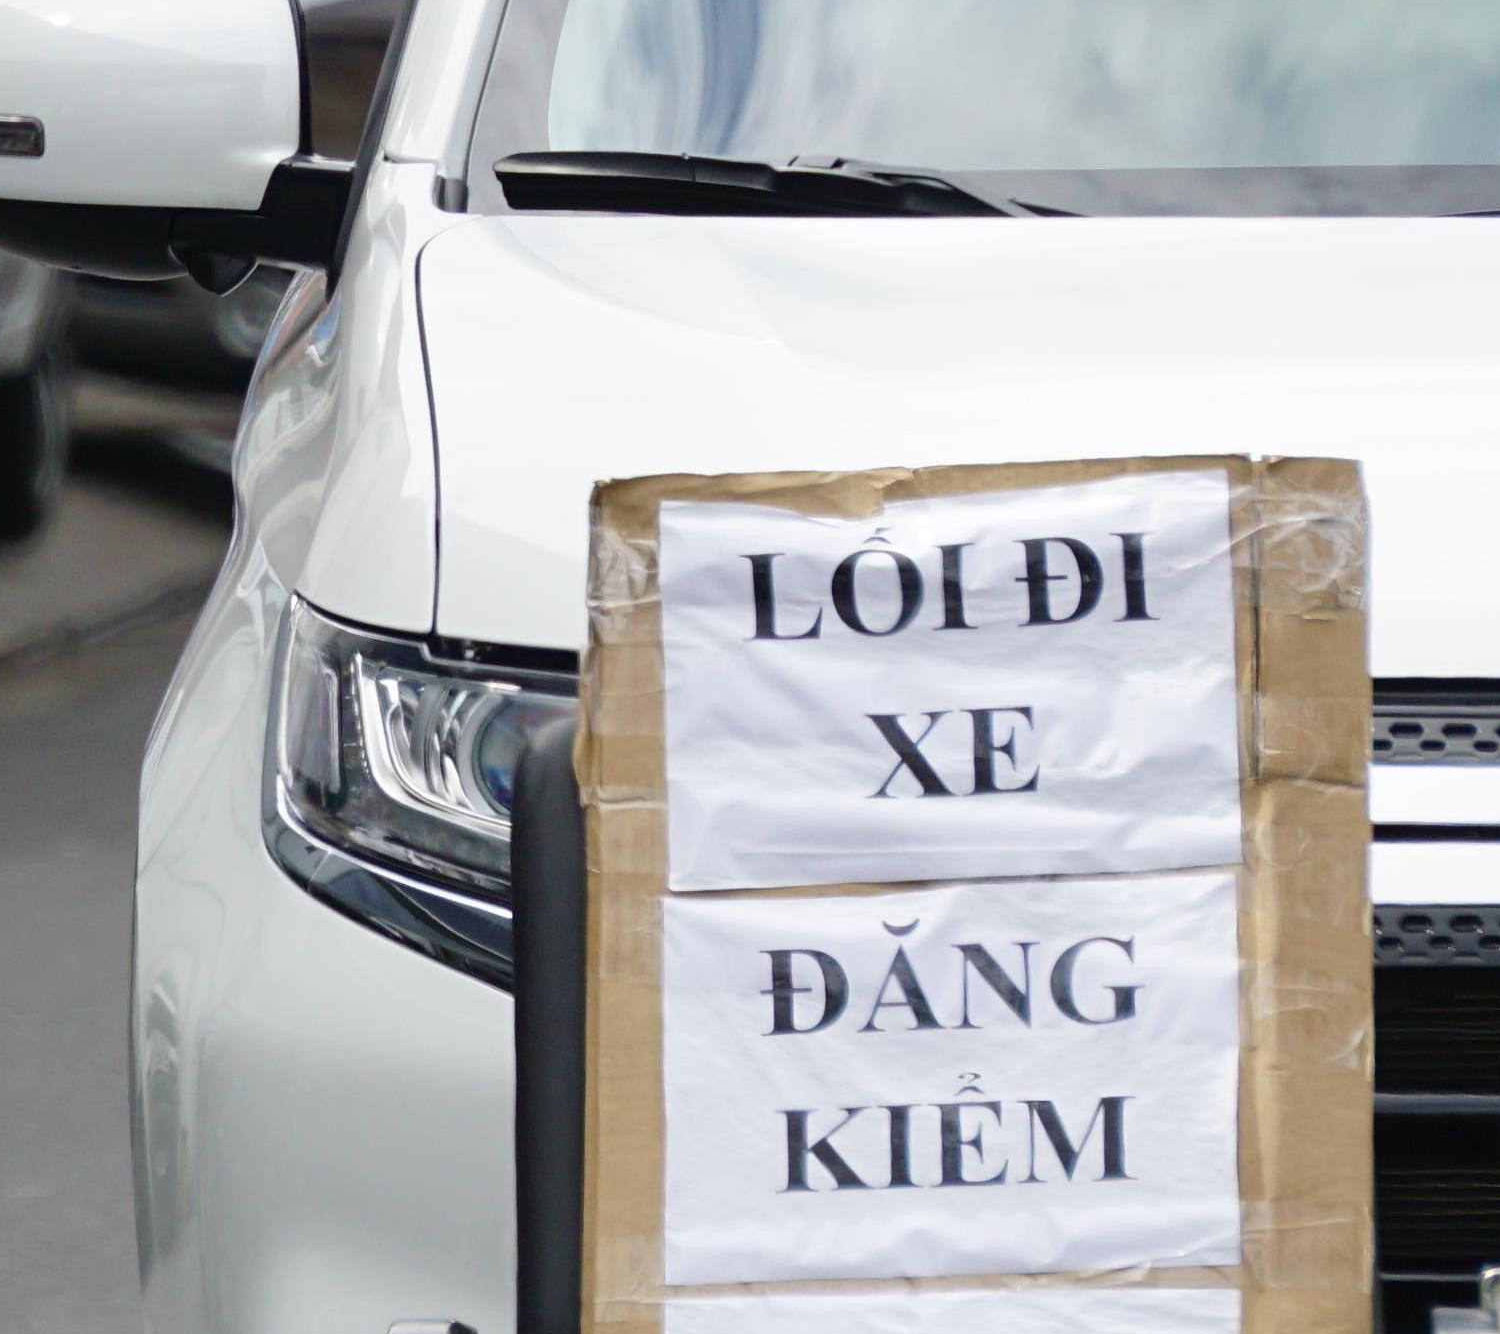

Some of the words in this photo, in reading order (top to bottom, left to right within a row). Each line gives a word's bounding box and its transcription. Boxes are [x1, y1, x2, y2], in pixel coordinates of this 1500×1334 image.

[740, 527, 978, 642] LỐI
[1013, 531, 1161, 628] ĐI
[865, 705, 1041, 800] XE
[758, 918, 1147, 1037] ĐĂNG
[776, 1071, 1139, 1194] KIỂM
